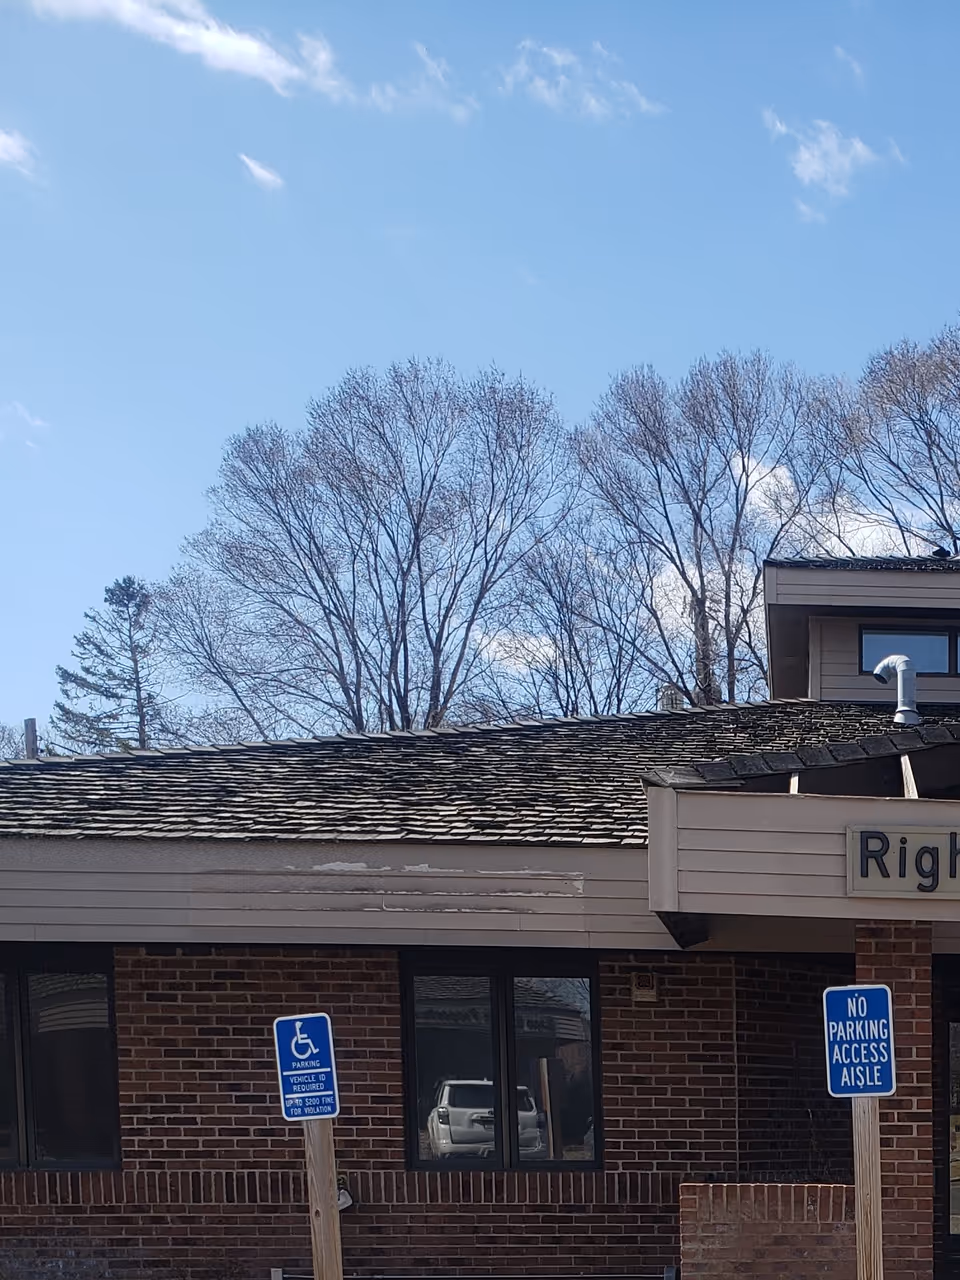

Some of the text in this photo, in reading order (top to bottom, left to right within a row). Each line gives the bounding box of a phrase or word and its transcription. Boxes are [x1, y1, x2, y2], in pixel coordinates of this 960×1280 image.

[847, 996, 867, 1017] NO
[829, 1019, 888, 1041] PARKING
[832, 1042, 888, 1064] ACCESS
[292, 1060, 320, 1068] PARKING
[290, 1075, 316, 1083] VEHICLE
[841, 1065, 882, 1087] AISLE
[293, 1083, 324, 1092] REQUIRED
[305, 1098, 320, 1106] $200
[322, 1096, 335, 1104] FINE
[304, 1106, 332, 1115] VIOLATION
